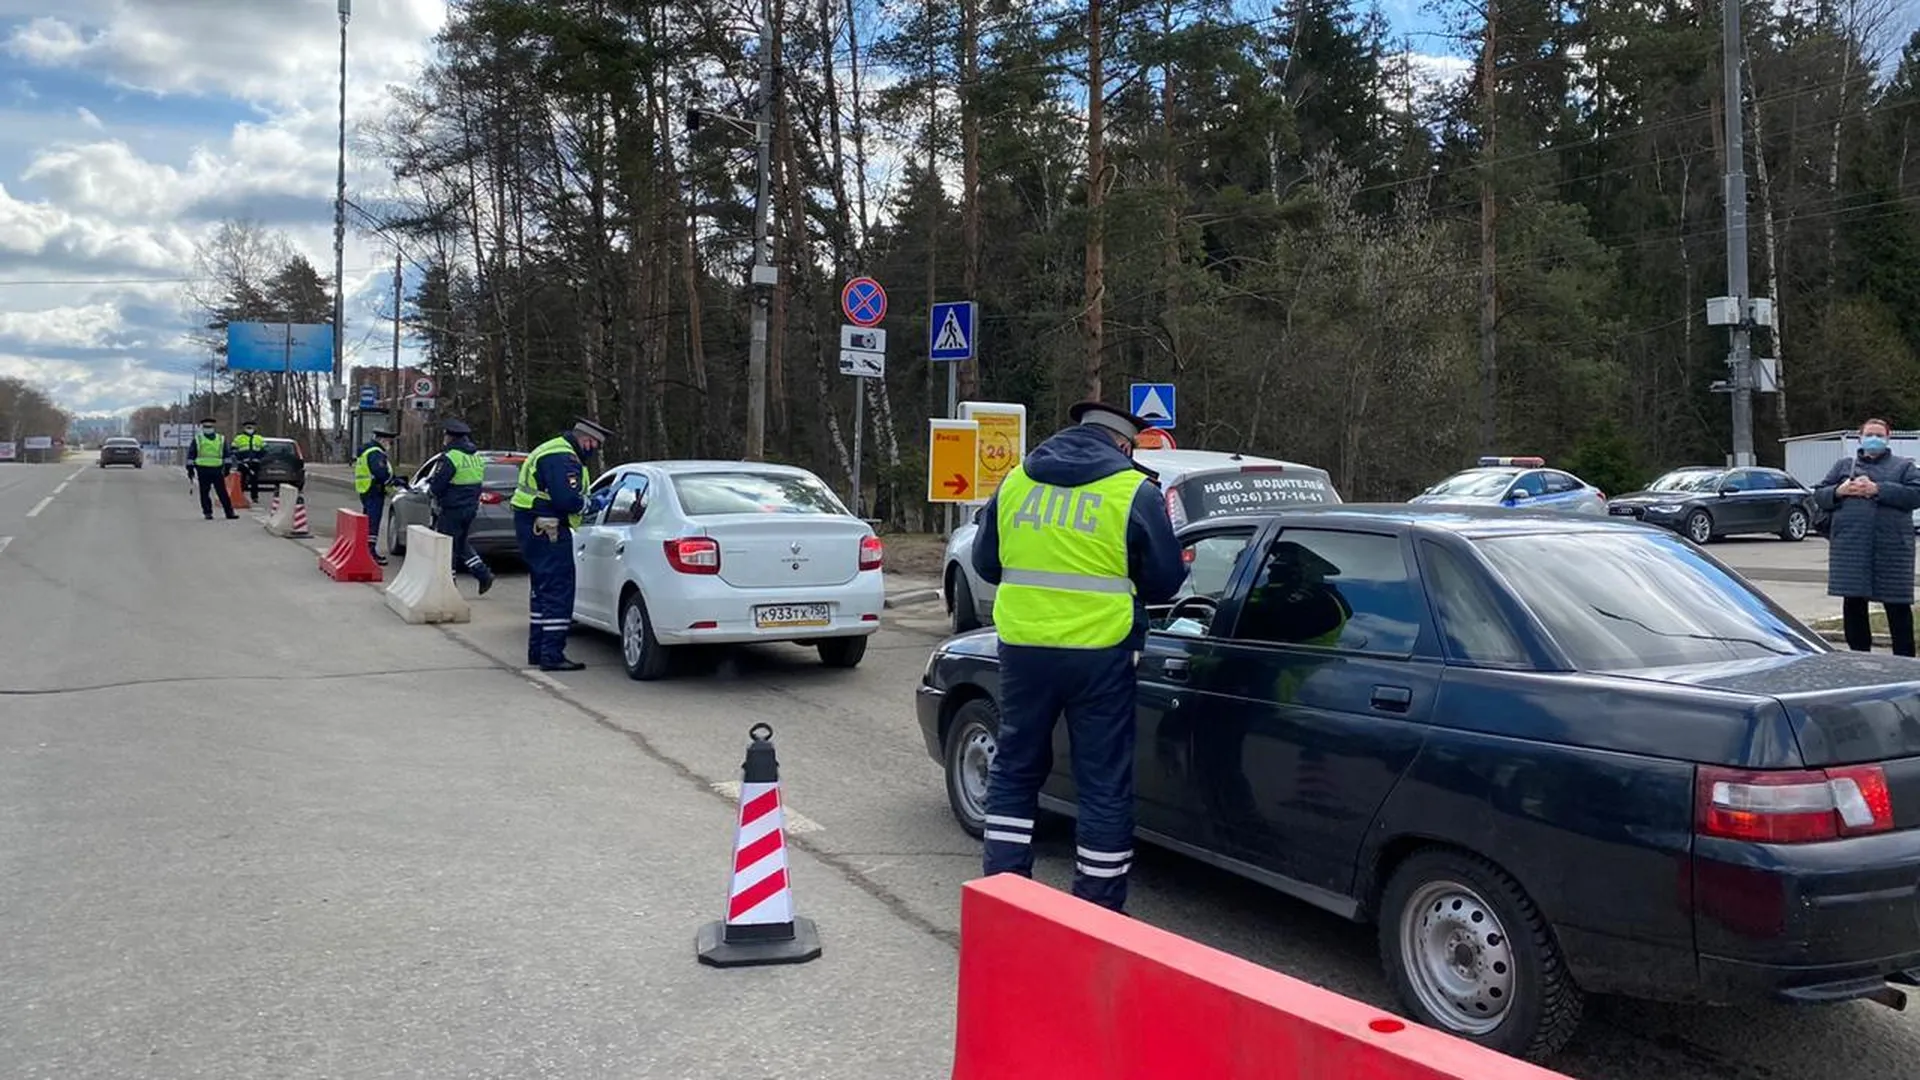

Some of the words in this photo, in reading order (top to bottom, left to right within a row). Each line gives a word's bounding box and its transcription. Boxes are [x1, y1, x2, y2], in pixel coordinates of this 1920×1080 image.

[417, 382, 430, 392] 50
[987, 444, 1005, 459] 24
[1013, 483, 1103, 533] ДПС
